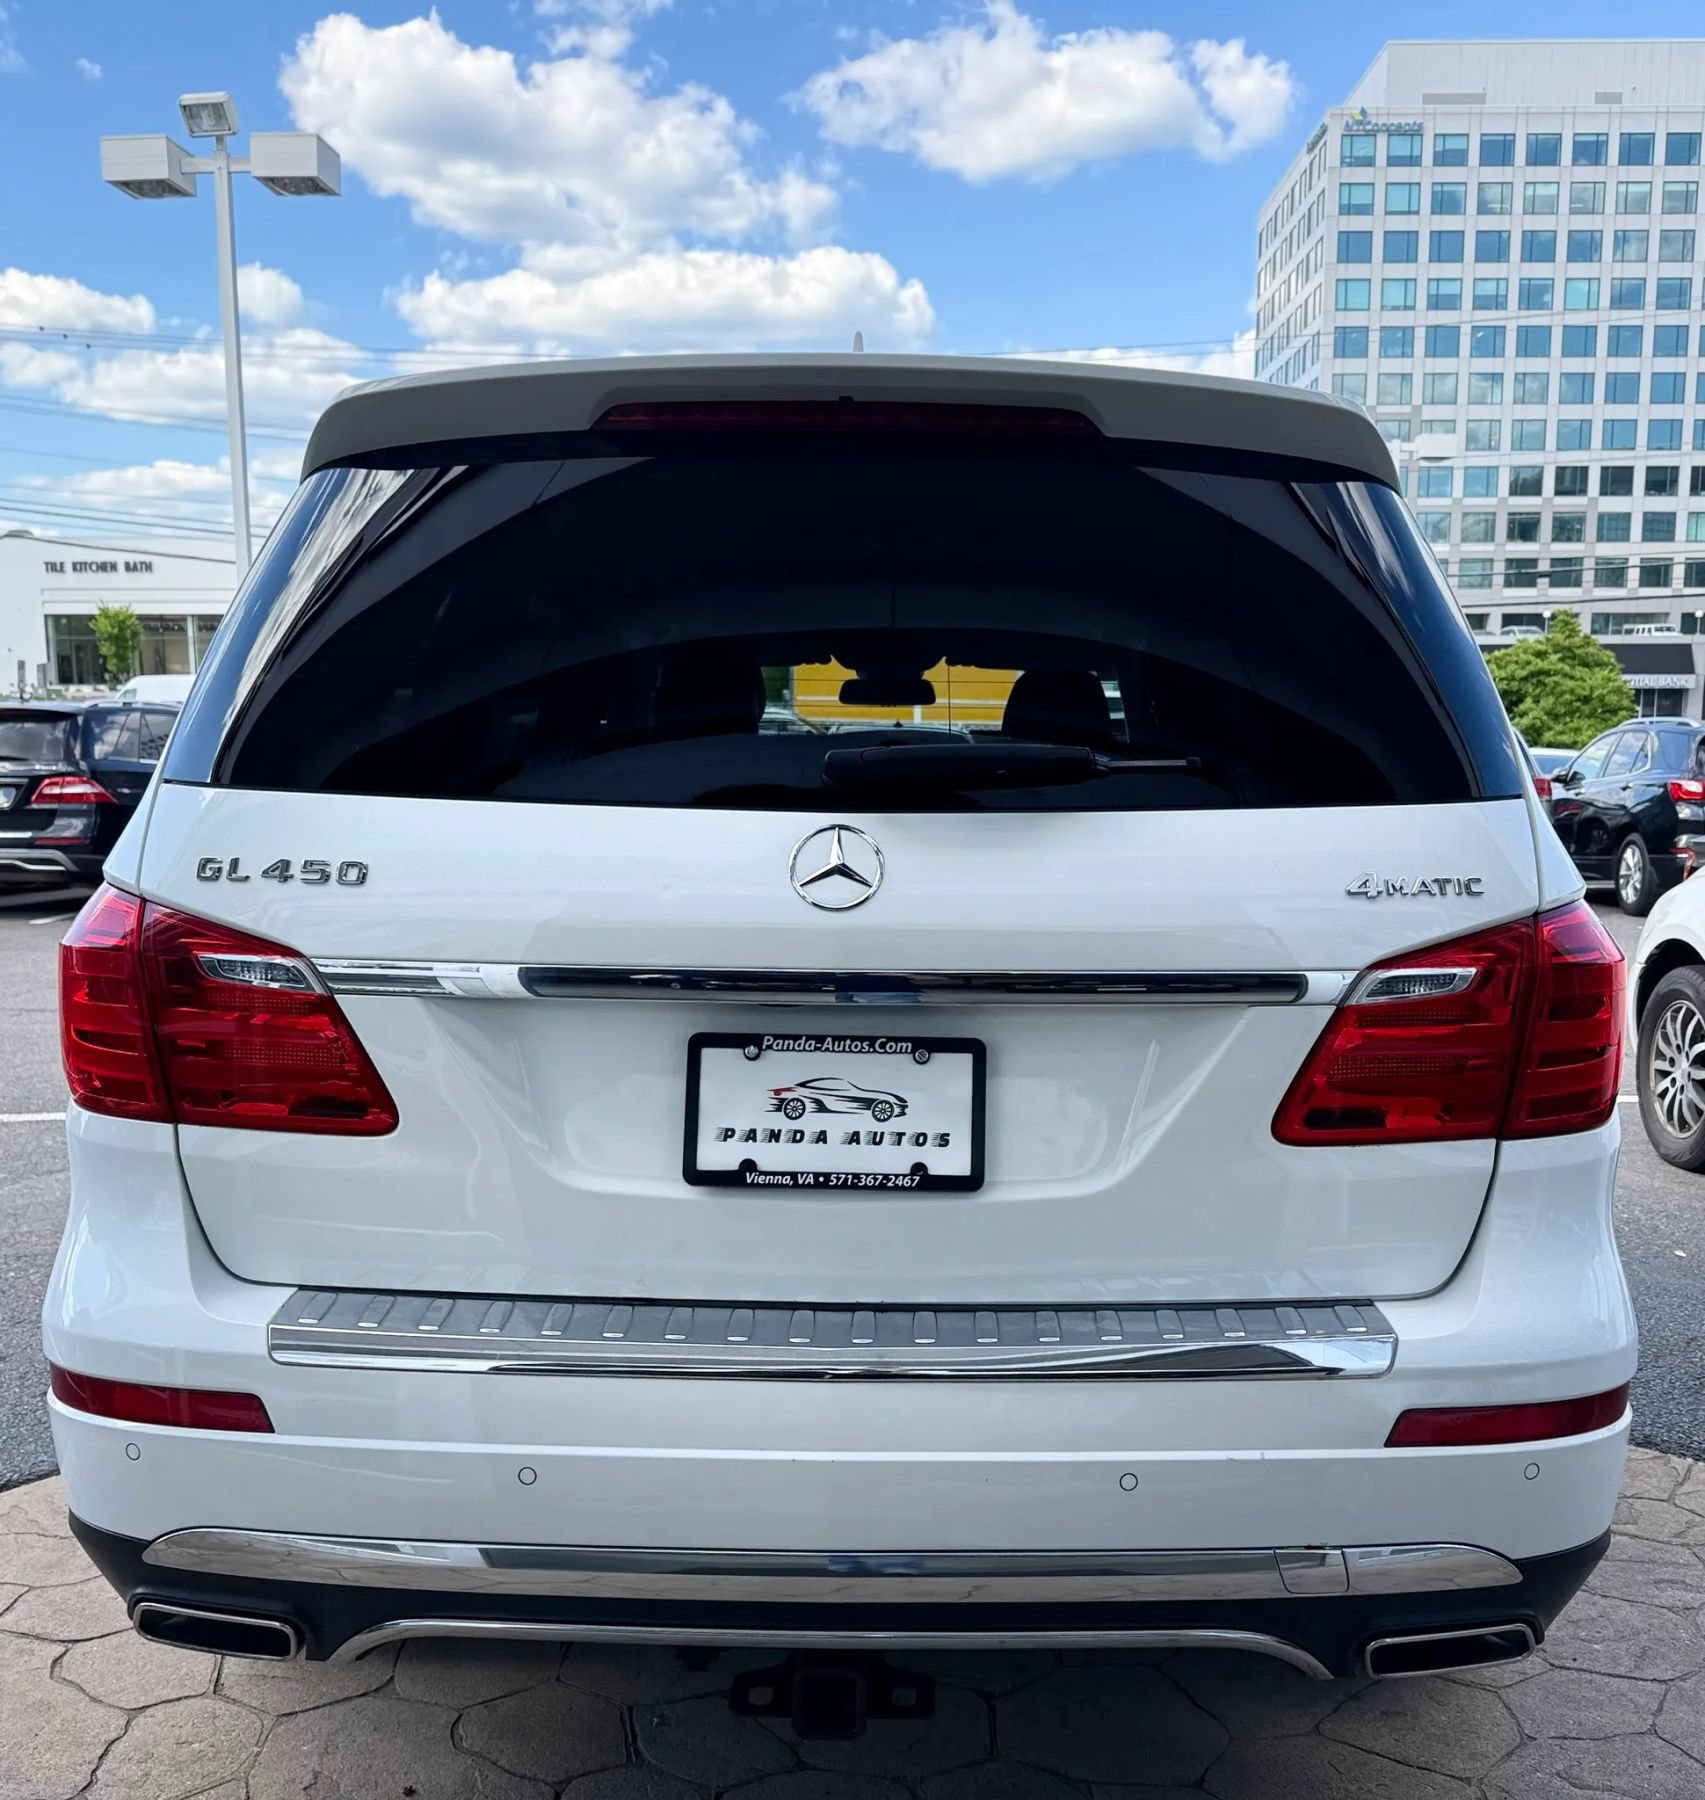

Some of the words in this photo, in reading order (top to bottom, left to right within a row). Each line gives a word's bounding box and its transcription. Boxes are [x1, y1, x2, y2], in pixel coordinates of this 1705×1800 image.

[43, 561, 66, 573] TILE
[71, 561, 118, 573] KITCHEN
[124, 561, 153, 573] BATH
[1658, 677, 1688, 687] BANK
[196, 856, 251, 882] GL
[260, 858, 370, 886] 450
[1345, 871, 1485, 898] 4MATIC
[762, 1036, 913, 1055] Panda-Autos.Com
[714, 1127, 828, 1145] PANDA
[840, 1130, 951, 1148] AUTOS
[746, 1172, 794, 1186] Vienna,
[797, 1173, 814, 1185] VA
[829, 1174, 921, 1188] 571-367-2467
